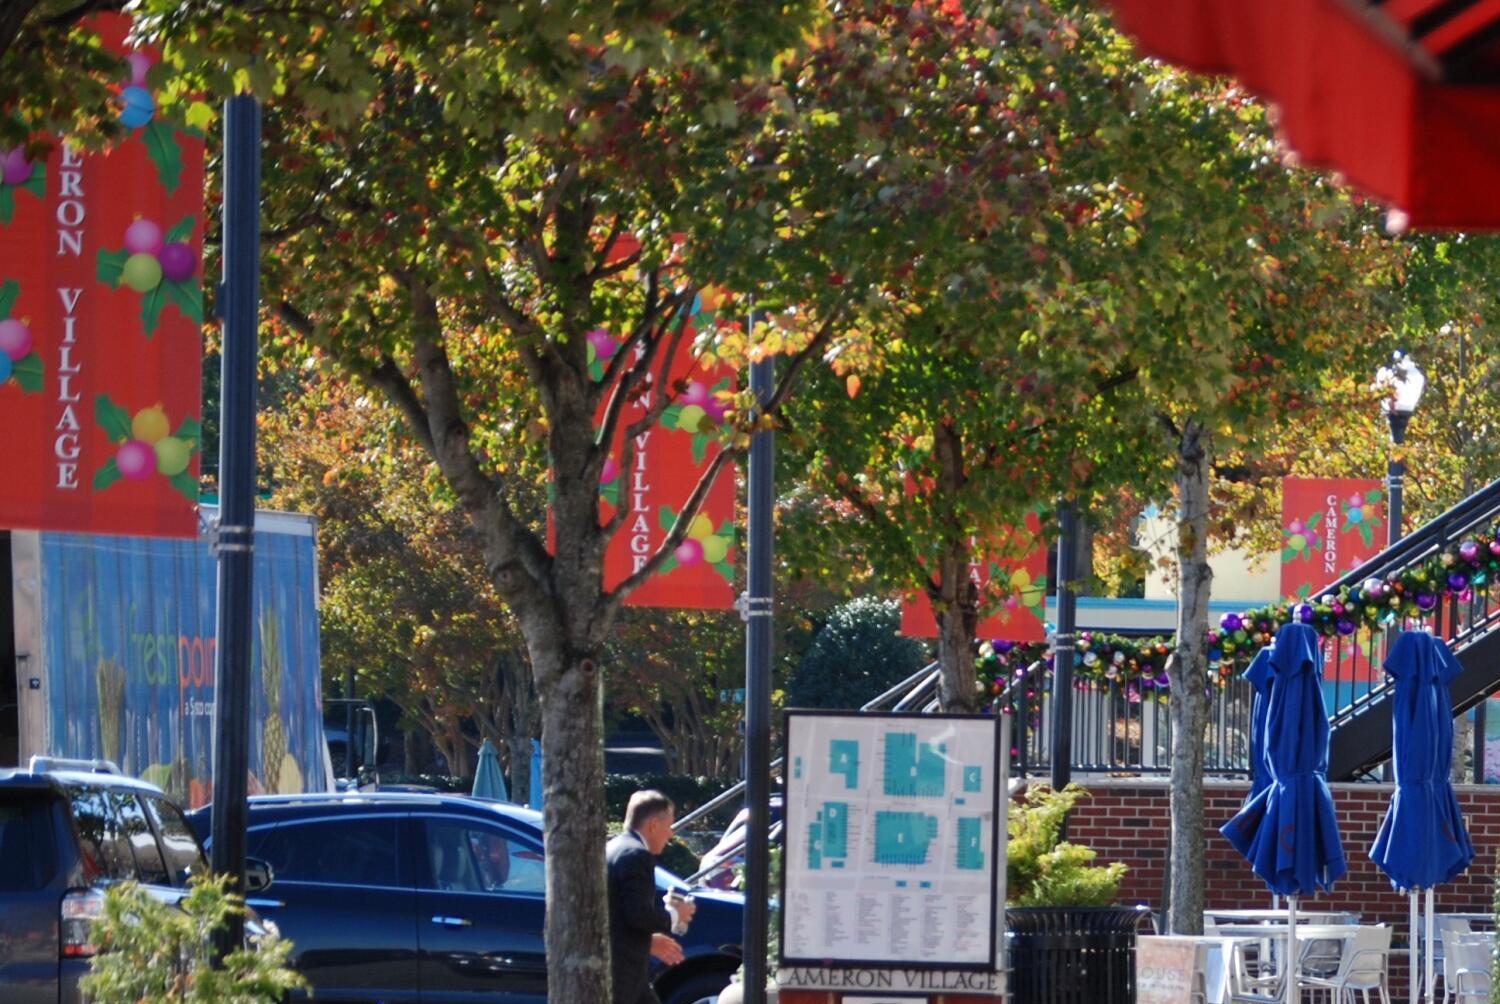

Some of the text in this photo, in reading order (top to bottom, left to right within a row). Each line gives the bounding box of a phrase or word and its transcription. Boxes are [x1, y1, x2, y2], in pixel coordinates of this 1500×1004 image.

[54, 142, 86, 489] ERON VILLAGE
[1324, 495, 1338, 574] CAMERON
[904, 970, 997, 990] VILLAGE
